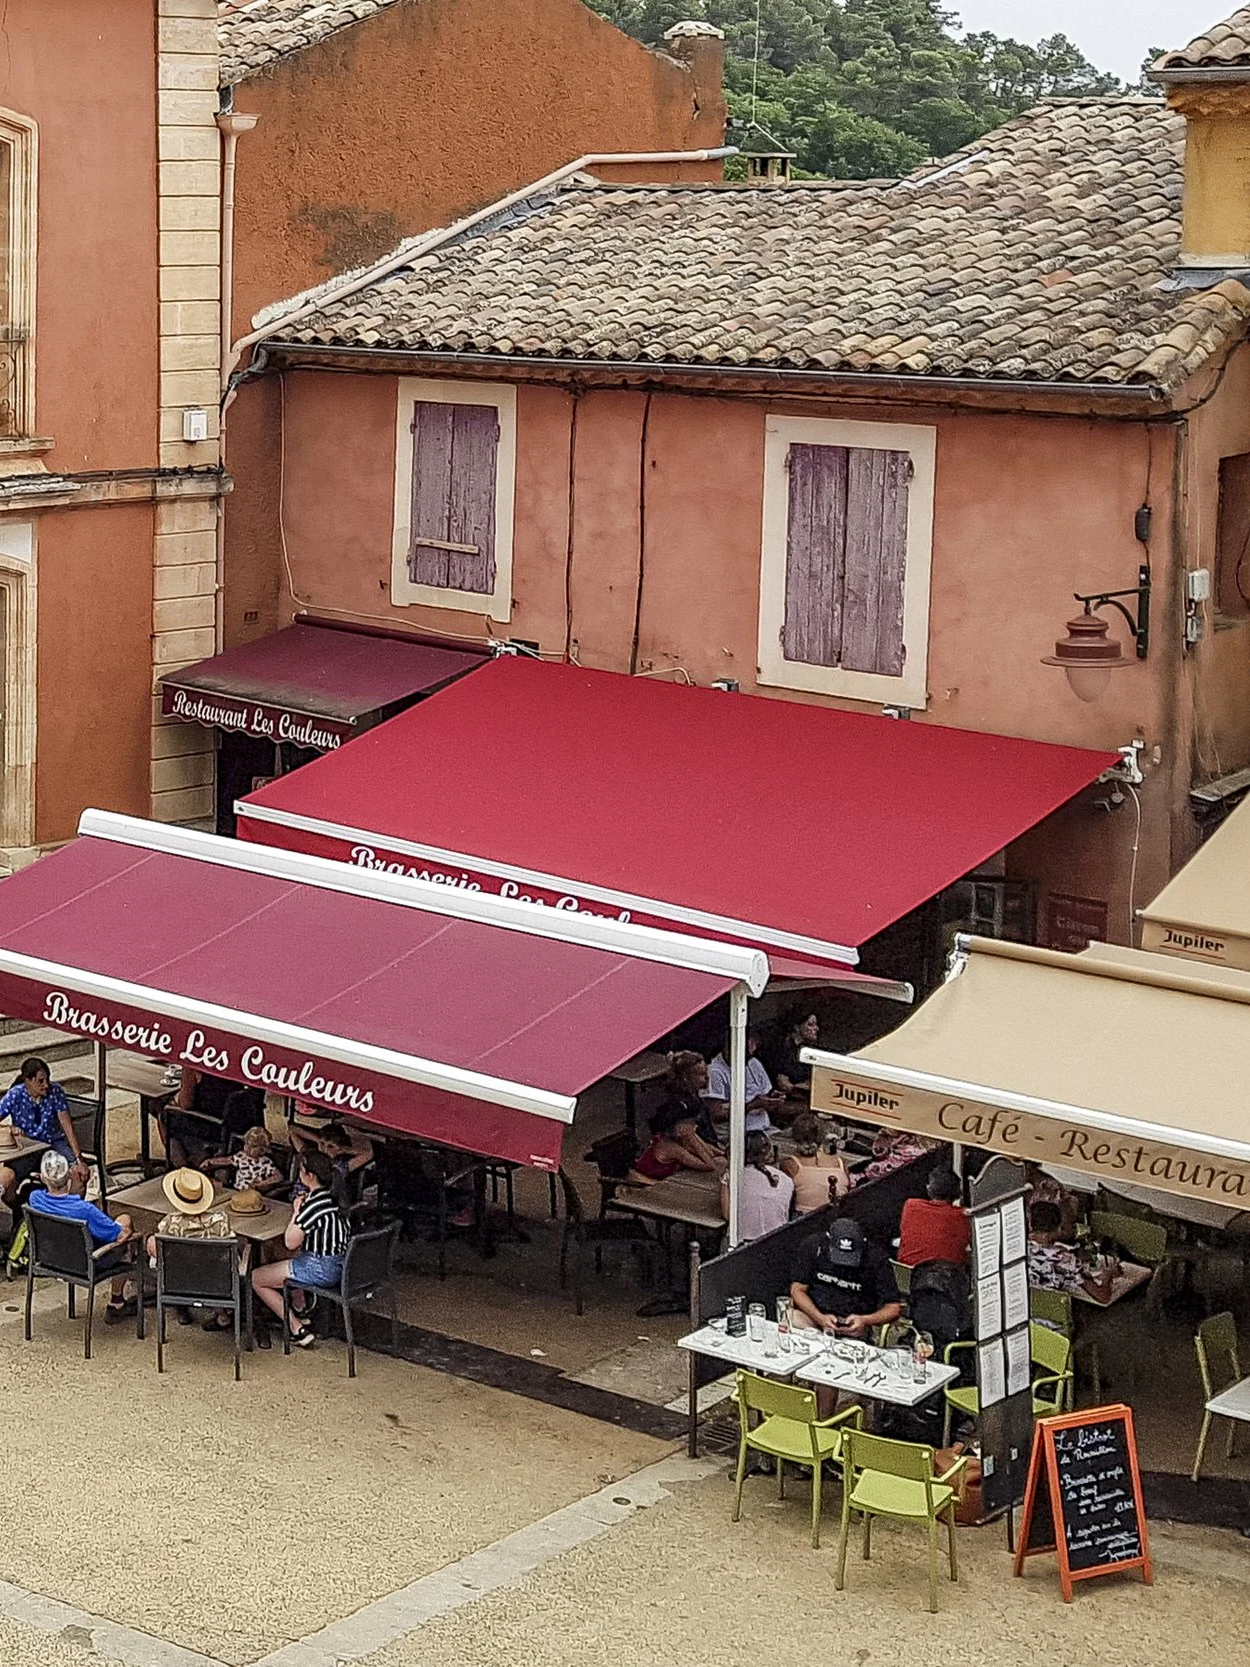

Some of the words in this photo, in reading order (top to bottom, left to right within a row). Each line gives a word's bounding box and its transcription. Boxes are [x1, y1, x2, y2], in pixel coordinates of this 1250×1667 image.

[172, 690, 248, 729] Restaurant
[251, 708, 274, 735] Les
[278, 713, 341, 750] Couleurs
[1164, 929, 1225, 952] Jupiler
[43, 991, 172, 1053] Brasserie
[179, 1029, 230, 1071] Les
[241, 1045, 375, 1113] Couleurs
[833, 1083, 900, 1111] Jupiler
[937, 1102, 1022, 1145] Café
[1060, 1129, 1250, 1196] Restaura
